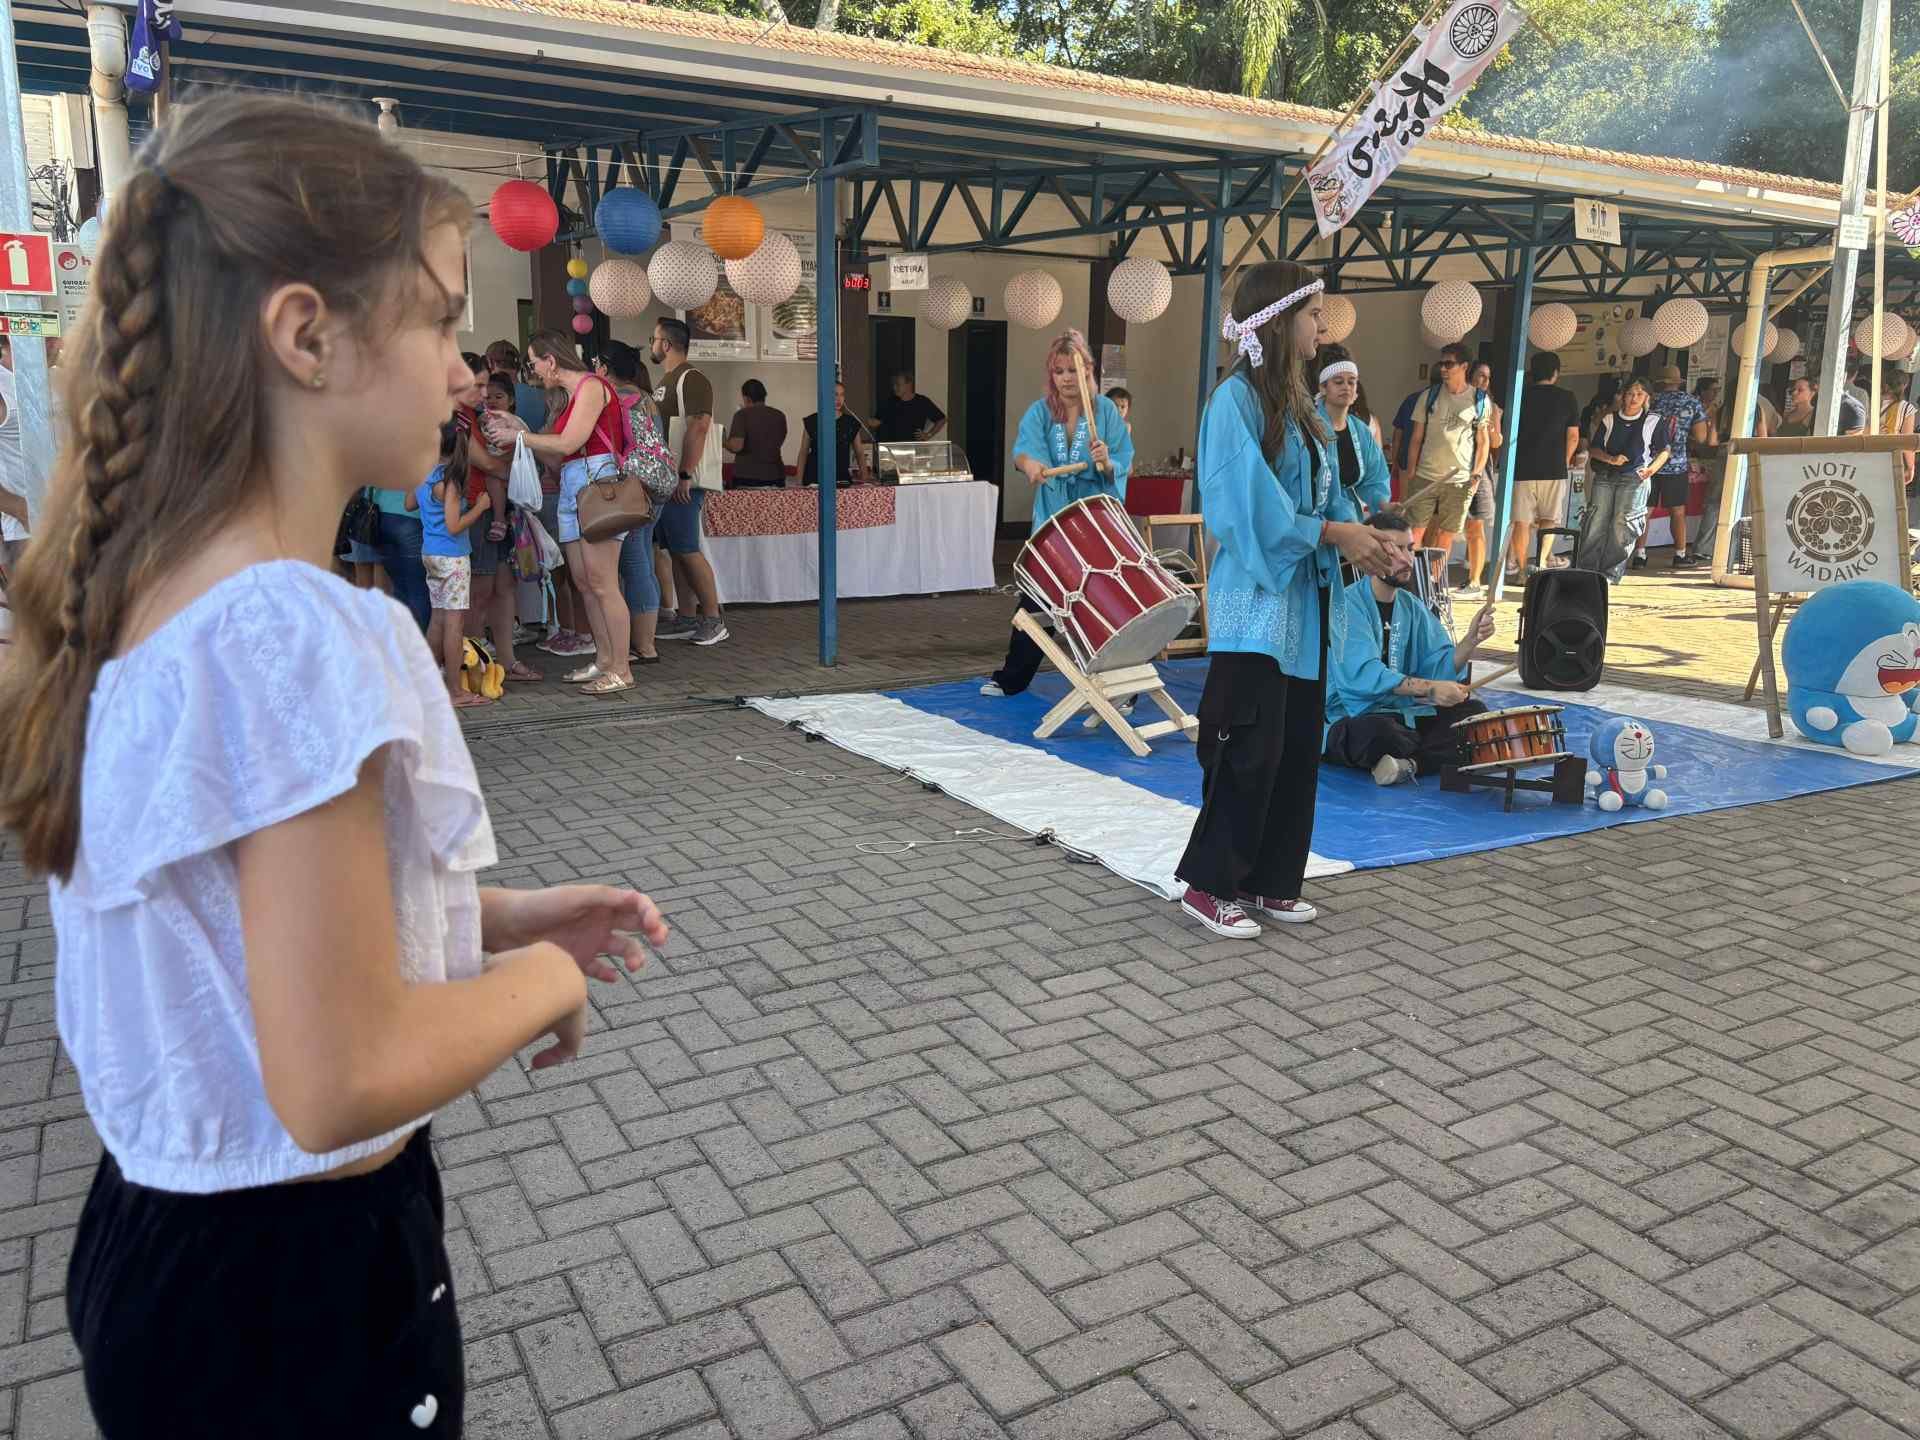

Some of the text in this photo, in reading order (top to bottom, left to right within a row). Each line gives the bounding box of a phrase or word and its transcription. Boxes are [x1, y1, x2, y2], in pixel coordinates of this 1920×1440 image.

[1347, 58, 1450, 178] 天ぷら
[893, 265, 924, 273] RETIRA
[1802, 462, 1856, 480] iVOTi
[1787, 550, 1879, 582] WADAiKO
